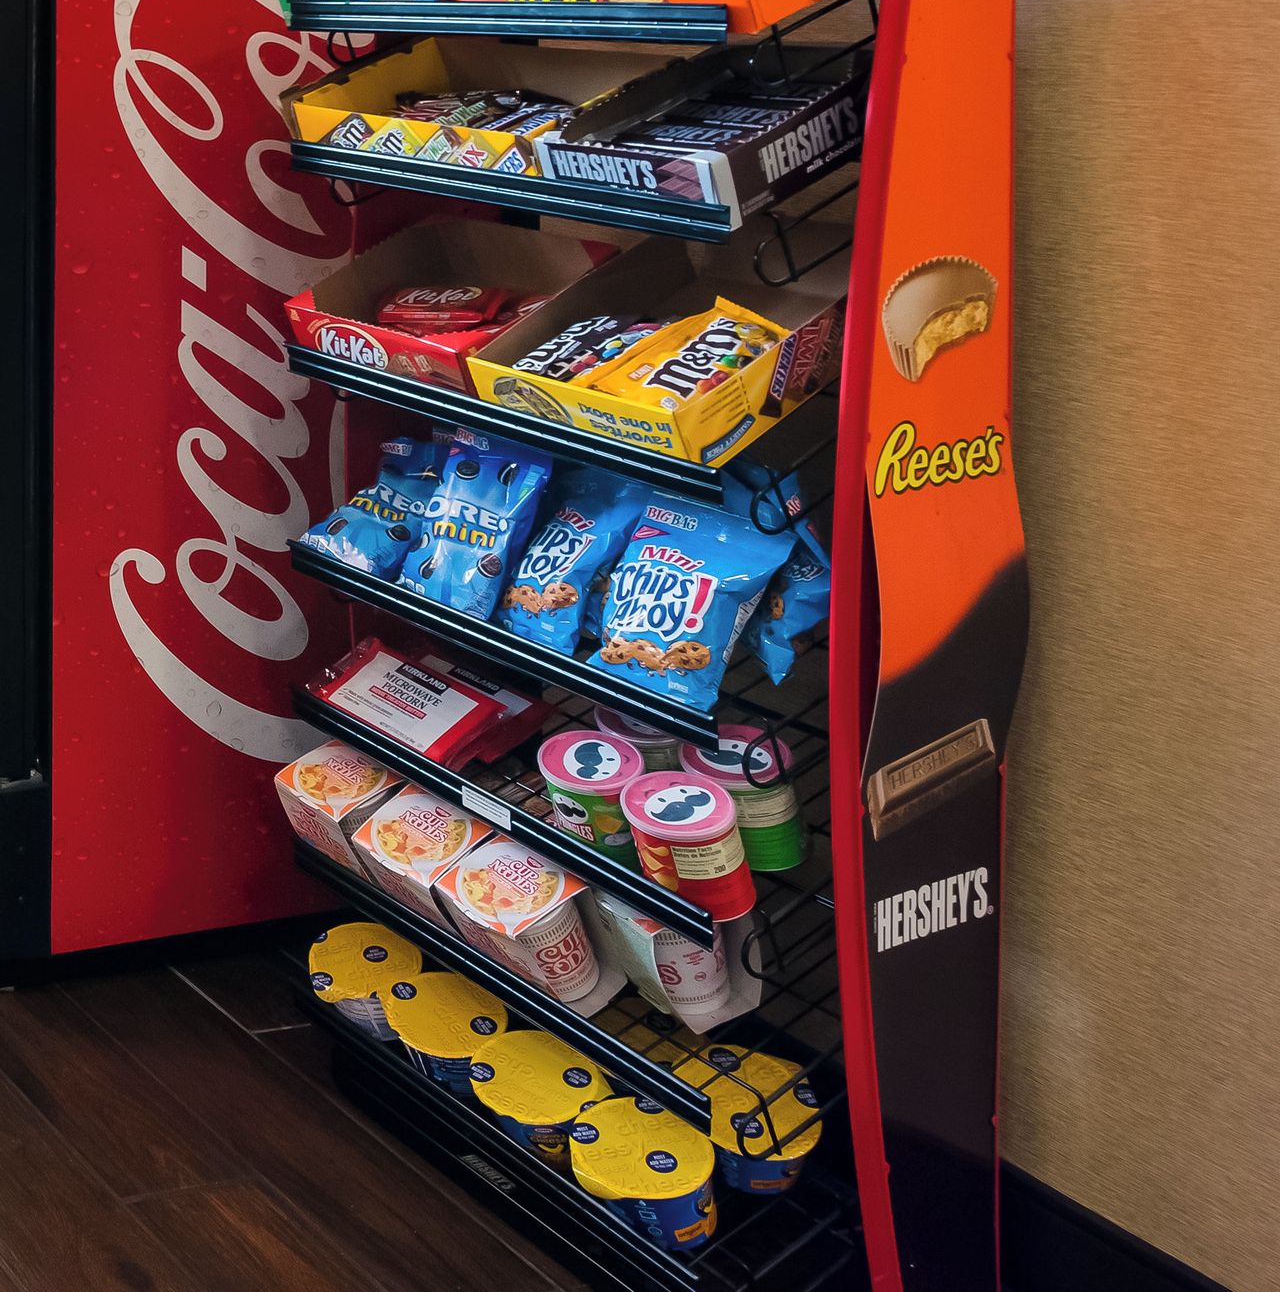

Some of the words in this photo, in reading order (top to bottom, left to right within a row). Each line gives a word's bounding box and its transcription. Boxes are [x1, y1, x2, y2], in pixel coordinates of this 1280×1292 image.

[761, 96, 859, 184] HERSHEY'S
[556, 149, 658, 190] HERSHEY'S
[320, 327, 387, 368] KitKat
[643, 316, 741, 401] m&m's
[791, 317, 826, 389] TWIX
[589, 419, 673, 449] Favorites
[620, 416, 653, 434] One
[656, 422, 672, 434] In
[874, 420, 1005, 499] Reese's
[348, 496, 406, 523] mini
[645, 505, 672, 523] BIG
[671, 513, 698, 531] BAG
[433, 520, 498, 549] mini
[534, 523, 584, 556] ips
[638, 544, 704, 572] Mini
[614, 559, 695, 602] Chips
[383, 671, 443, 708] MICROWAVE
[401, 664, 448, 692] KIRKLAND
[454, 667, 500, 692] KIRKLAND
[381, 681, 429, 710] POPCORN
[323, 757, 365, 786] NOODLES
[341, 757, 367, 777] CUP
[400, 810, 449, 843] NOODLES
[419, 810, 449, 829] CUP
[488, 859, 540, 896] NOODLES
[509, 860, 540, 883] CUP
[714, 864, 727, 874] 200
[877, 866, 989, 953] HERSHEY'S
